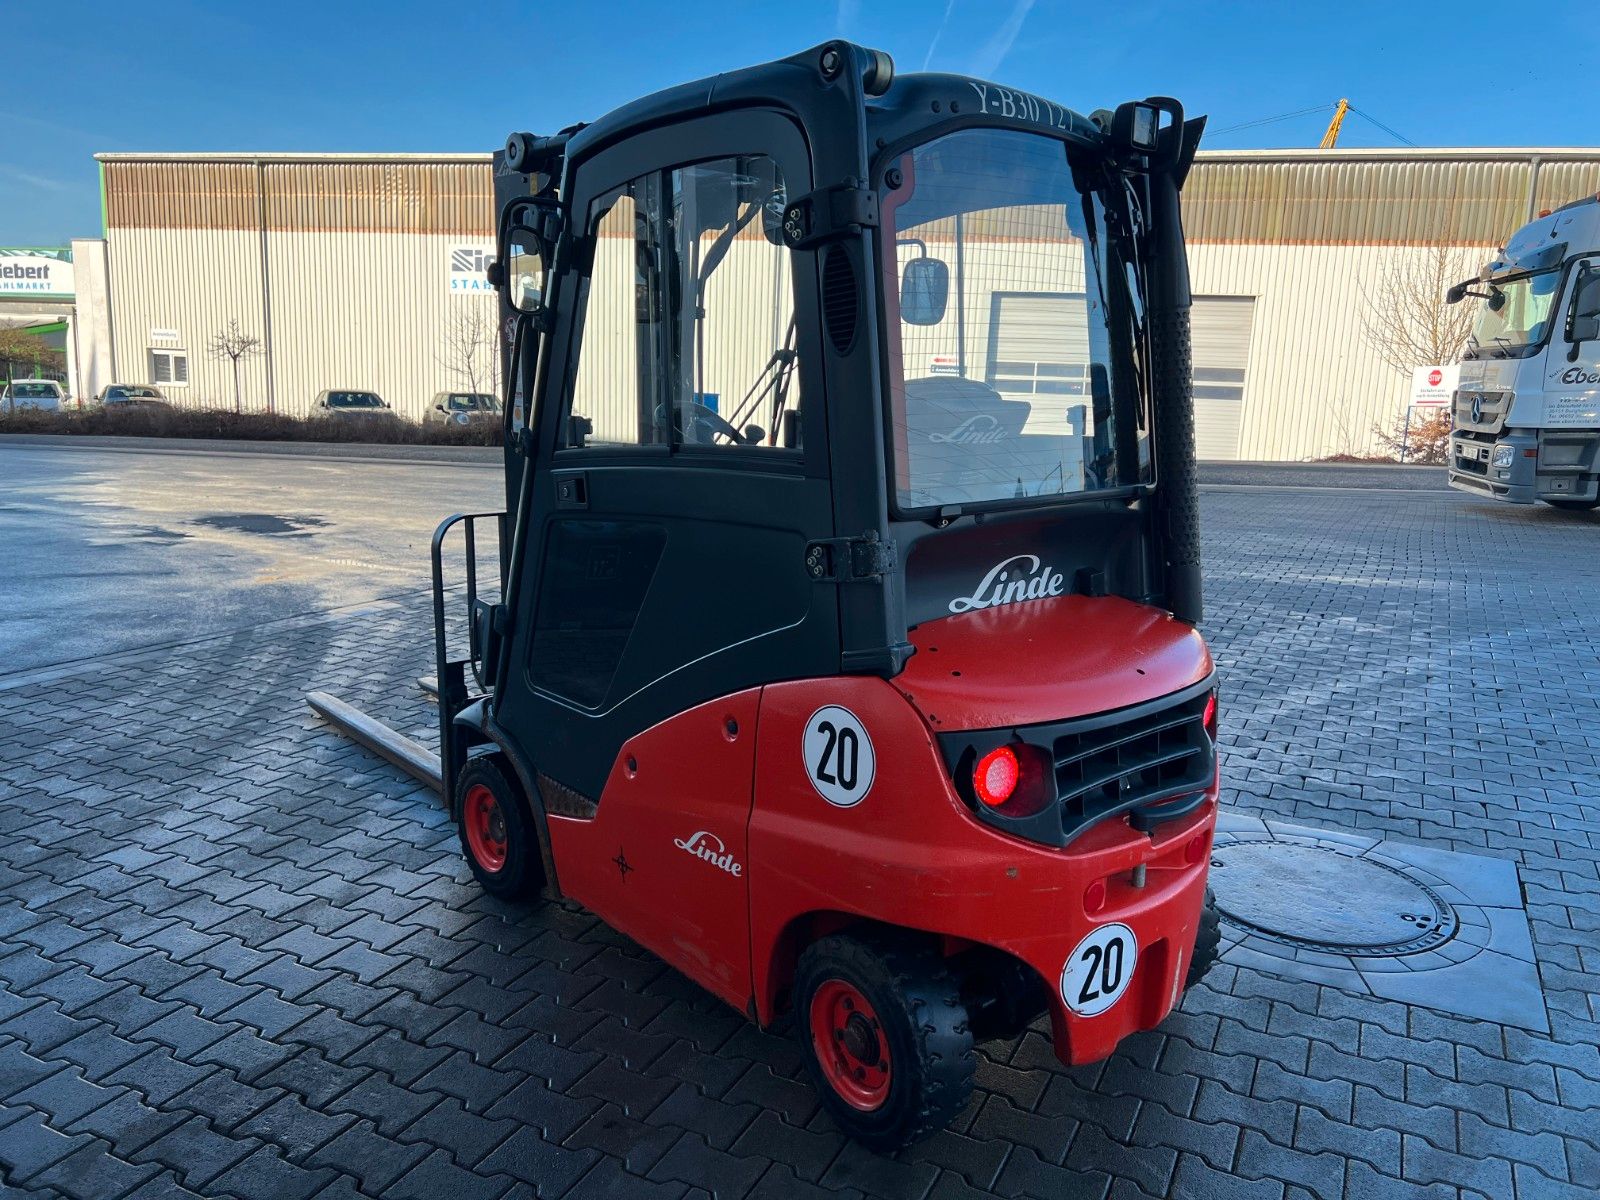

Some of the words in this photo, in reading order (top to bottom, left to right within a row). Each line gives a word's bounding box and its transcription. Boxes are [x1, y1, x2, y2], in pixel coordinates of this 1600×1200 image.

[928, 414, 1009, 445] Linde
[948, 554, 1064, 613] Linde
[816, 720, 859, 791] 20
[673, 831, 742, 877] Linde
[1078, 937, 1124, 1005] 20
